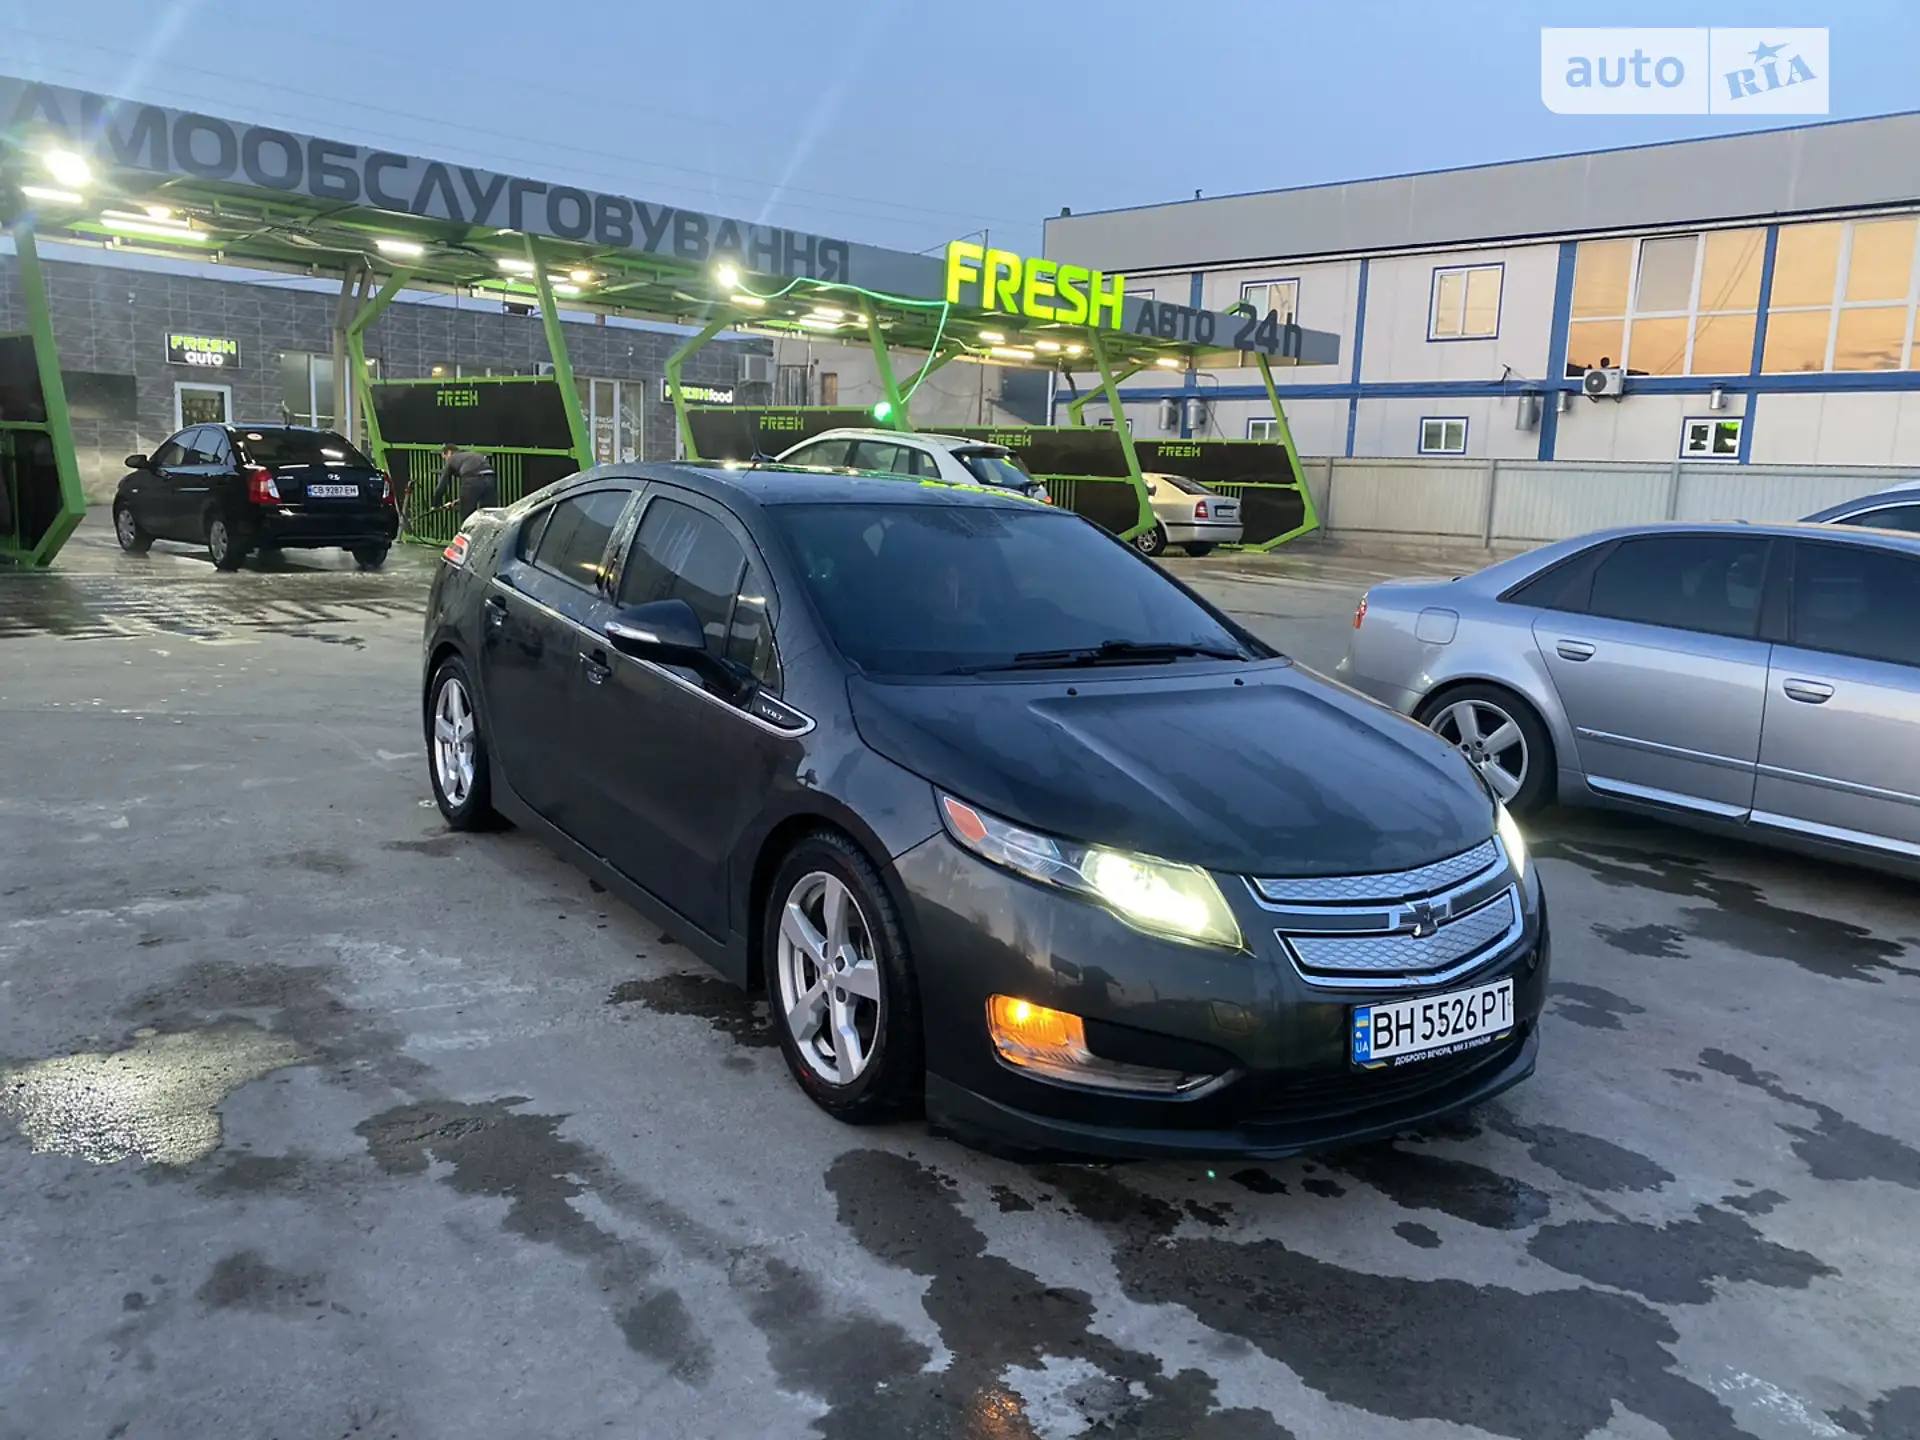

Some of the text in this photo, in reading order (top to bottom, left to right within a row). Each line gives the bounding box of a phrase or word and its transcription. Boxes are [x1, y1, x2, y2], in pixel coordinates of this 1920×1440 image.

[946, 240, 1125, 330] FRESH
[1135, 300, 1303, 360] АВТО 24h
[170, 335, 237, 354] FRESH
[184, 351, 224, 365] auto
[437, 389, 479, 407] FRESH
[759, 415, 804, 431] FRESH
[987, 433, 1032, 447] FRESH
[1157, 446, 1201, 457] FRESH
[1373, 984, 1511, 1050] BH 5526 PT
[1355, 1041, 1369, 1053] UA
